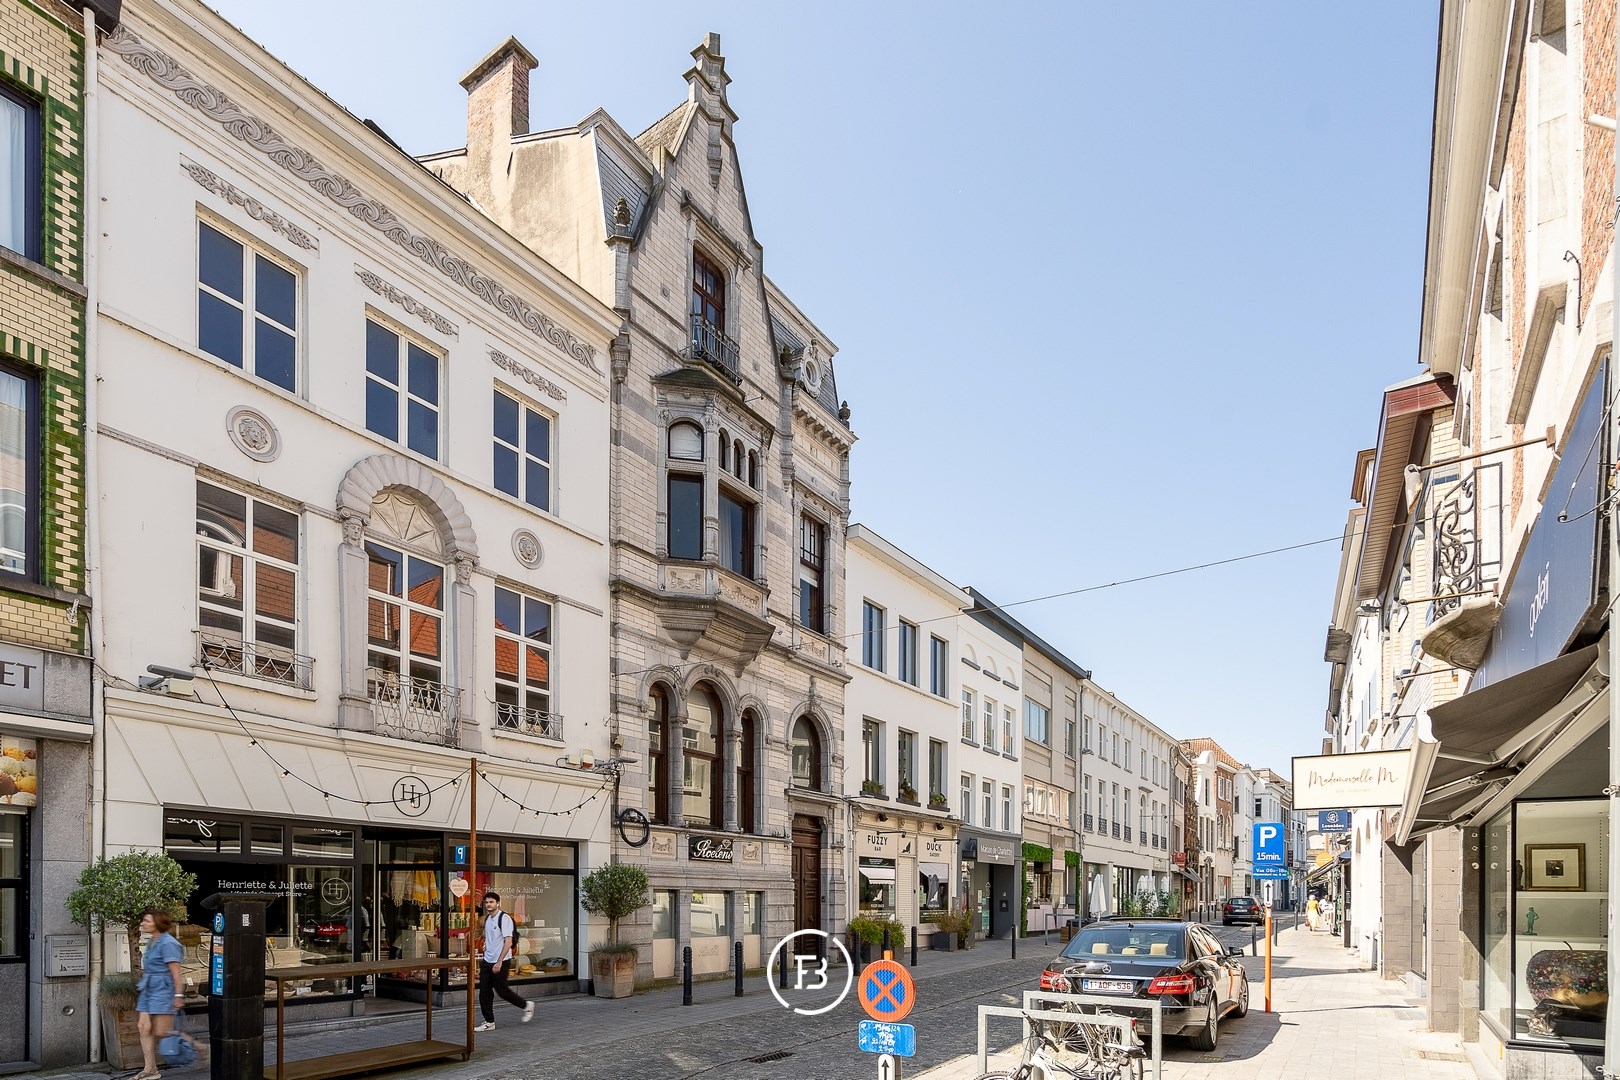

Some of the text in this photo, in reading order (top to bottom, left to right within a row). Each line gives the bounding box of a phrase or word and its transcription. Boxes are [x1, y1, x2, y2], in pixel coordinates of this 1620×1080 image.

[867, 835, 888, 846] FUZZY
[1259, 826, 1277, 848] P
[926, 842, 942, 852] DUCK
[217, 879, 313, 890] Henriette & Juliette
